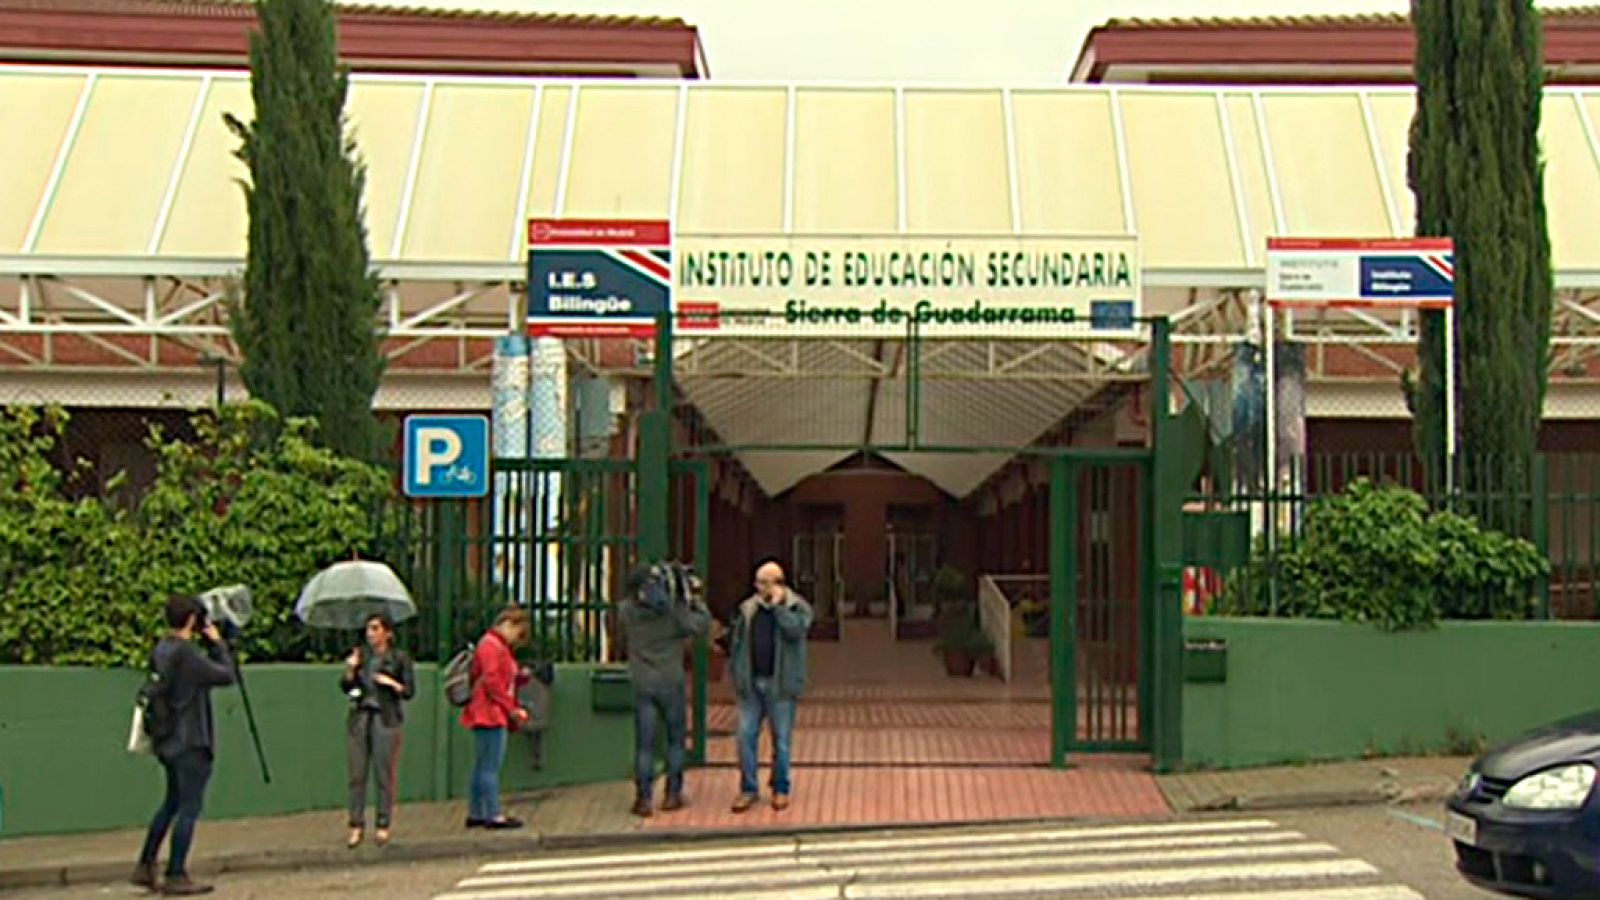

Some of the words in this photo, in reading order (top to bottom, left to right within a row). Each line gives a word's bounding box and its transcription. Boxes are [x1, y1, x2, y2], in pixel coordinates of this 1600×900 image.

[679, 251, 793, 286] INSTITUTO
[805, 251, 831, 286] DE
[844, 241, 975, 286] EDUCACIÓN
[986, 251, 1131, 286] SECUNDARIA
[549, 294, 632, 315] Bilingüe
[785, 299, 861, 323] Sierra
[871, 299, 902, 323] de
[915, 299, 1075, 323] Guadarrama
[415, 428, 462, 484] P
